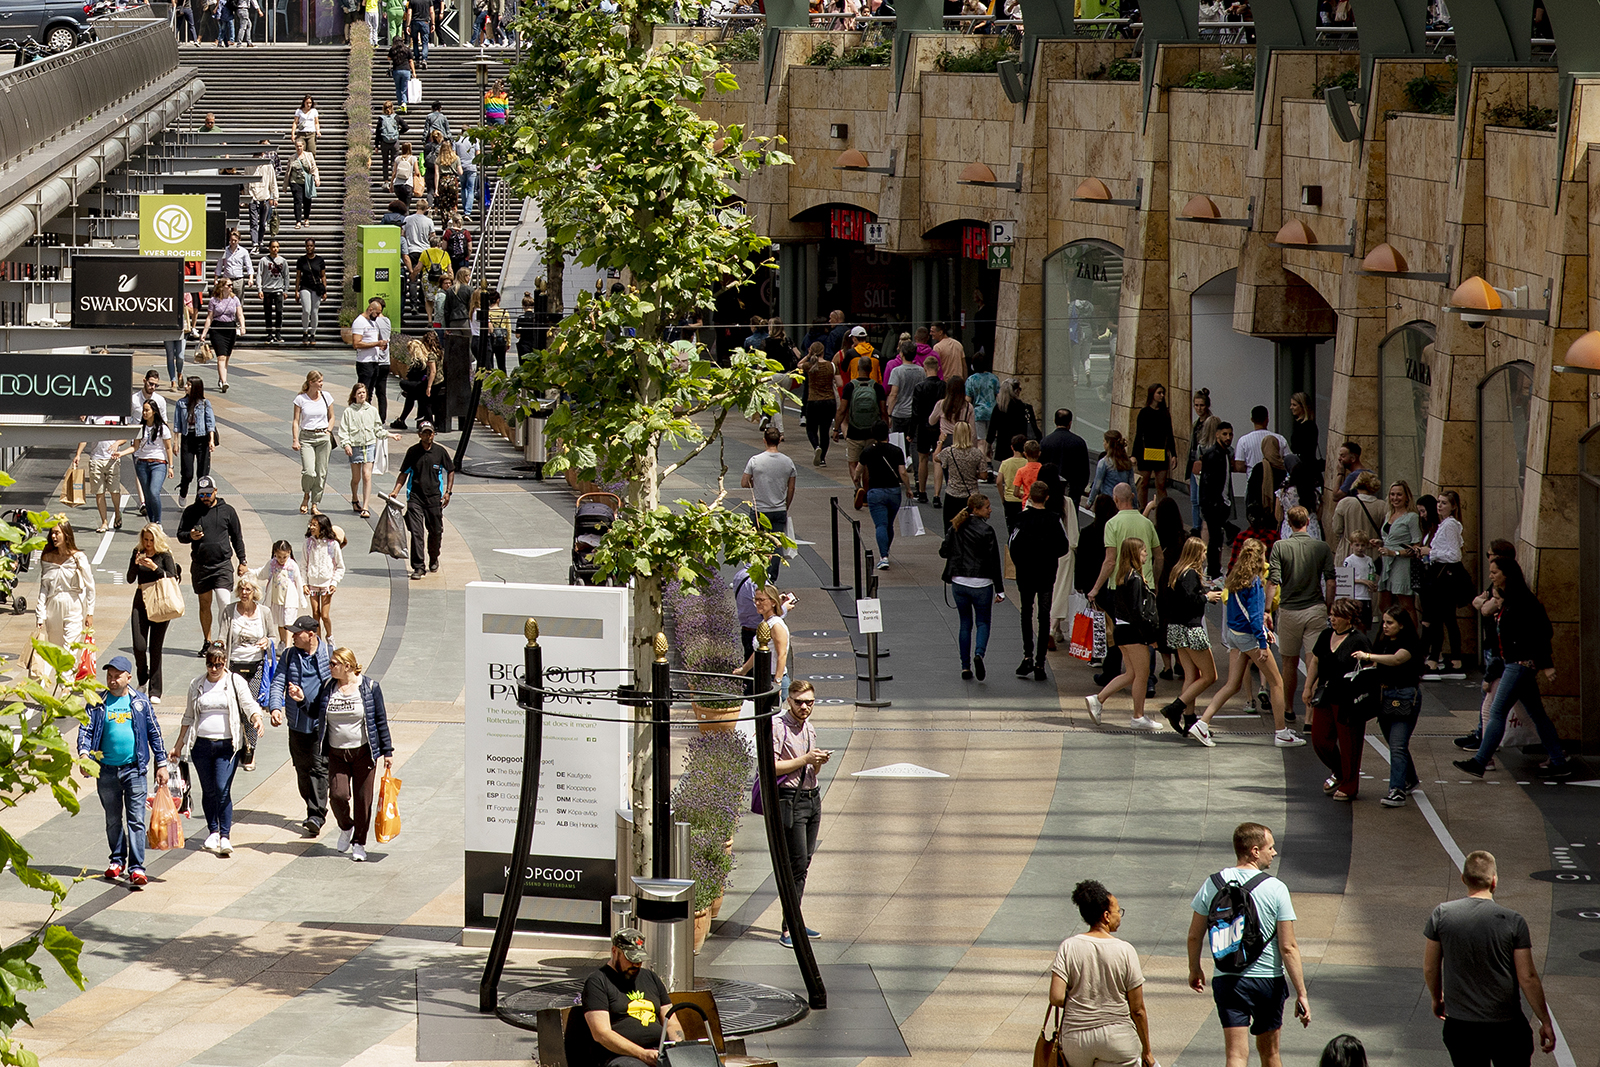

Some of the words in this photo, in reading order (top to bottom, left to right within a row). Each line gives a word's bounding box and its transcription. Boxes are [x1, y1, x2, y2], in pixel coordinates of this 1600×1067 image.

[993, 225, 1004, 242] P
[1076, 262, 1108, 282] ZARA
[80, 295, 174, 312] SWAROVSKI
[864, 289, 896, 308] SALE
[1406, 358, 1432, 387] ZARA
[0, 373, 112, 397] DOUGLAS
[542, 665, 597, 685] OUR
[487, 684, 595, 705] PADON?
[501, 708, 526, 716] Koopgo
[486, 754, 523, 763] Koopgoot
[504, 865, 583, 882] KOPGOOT
[1212, 915, 1245, 953] NIKE
